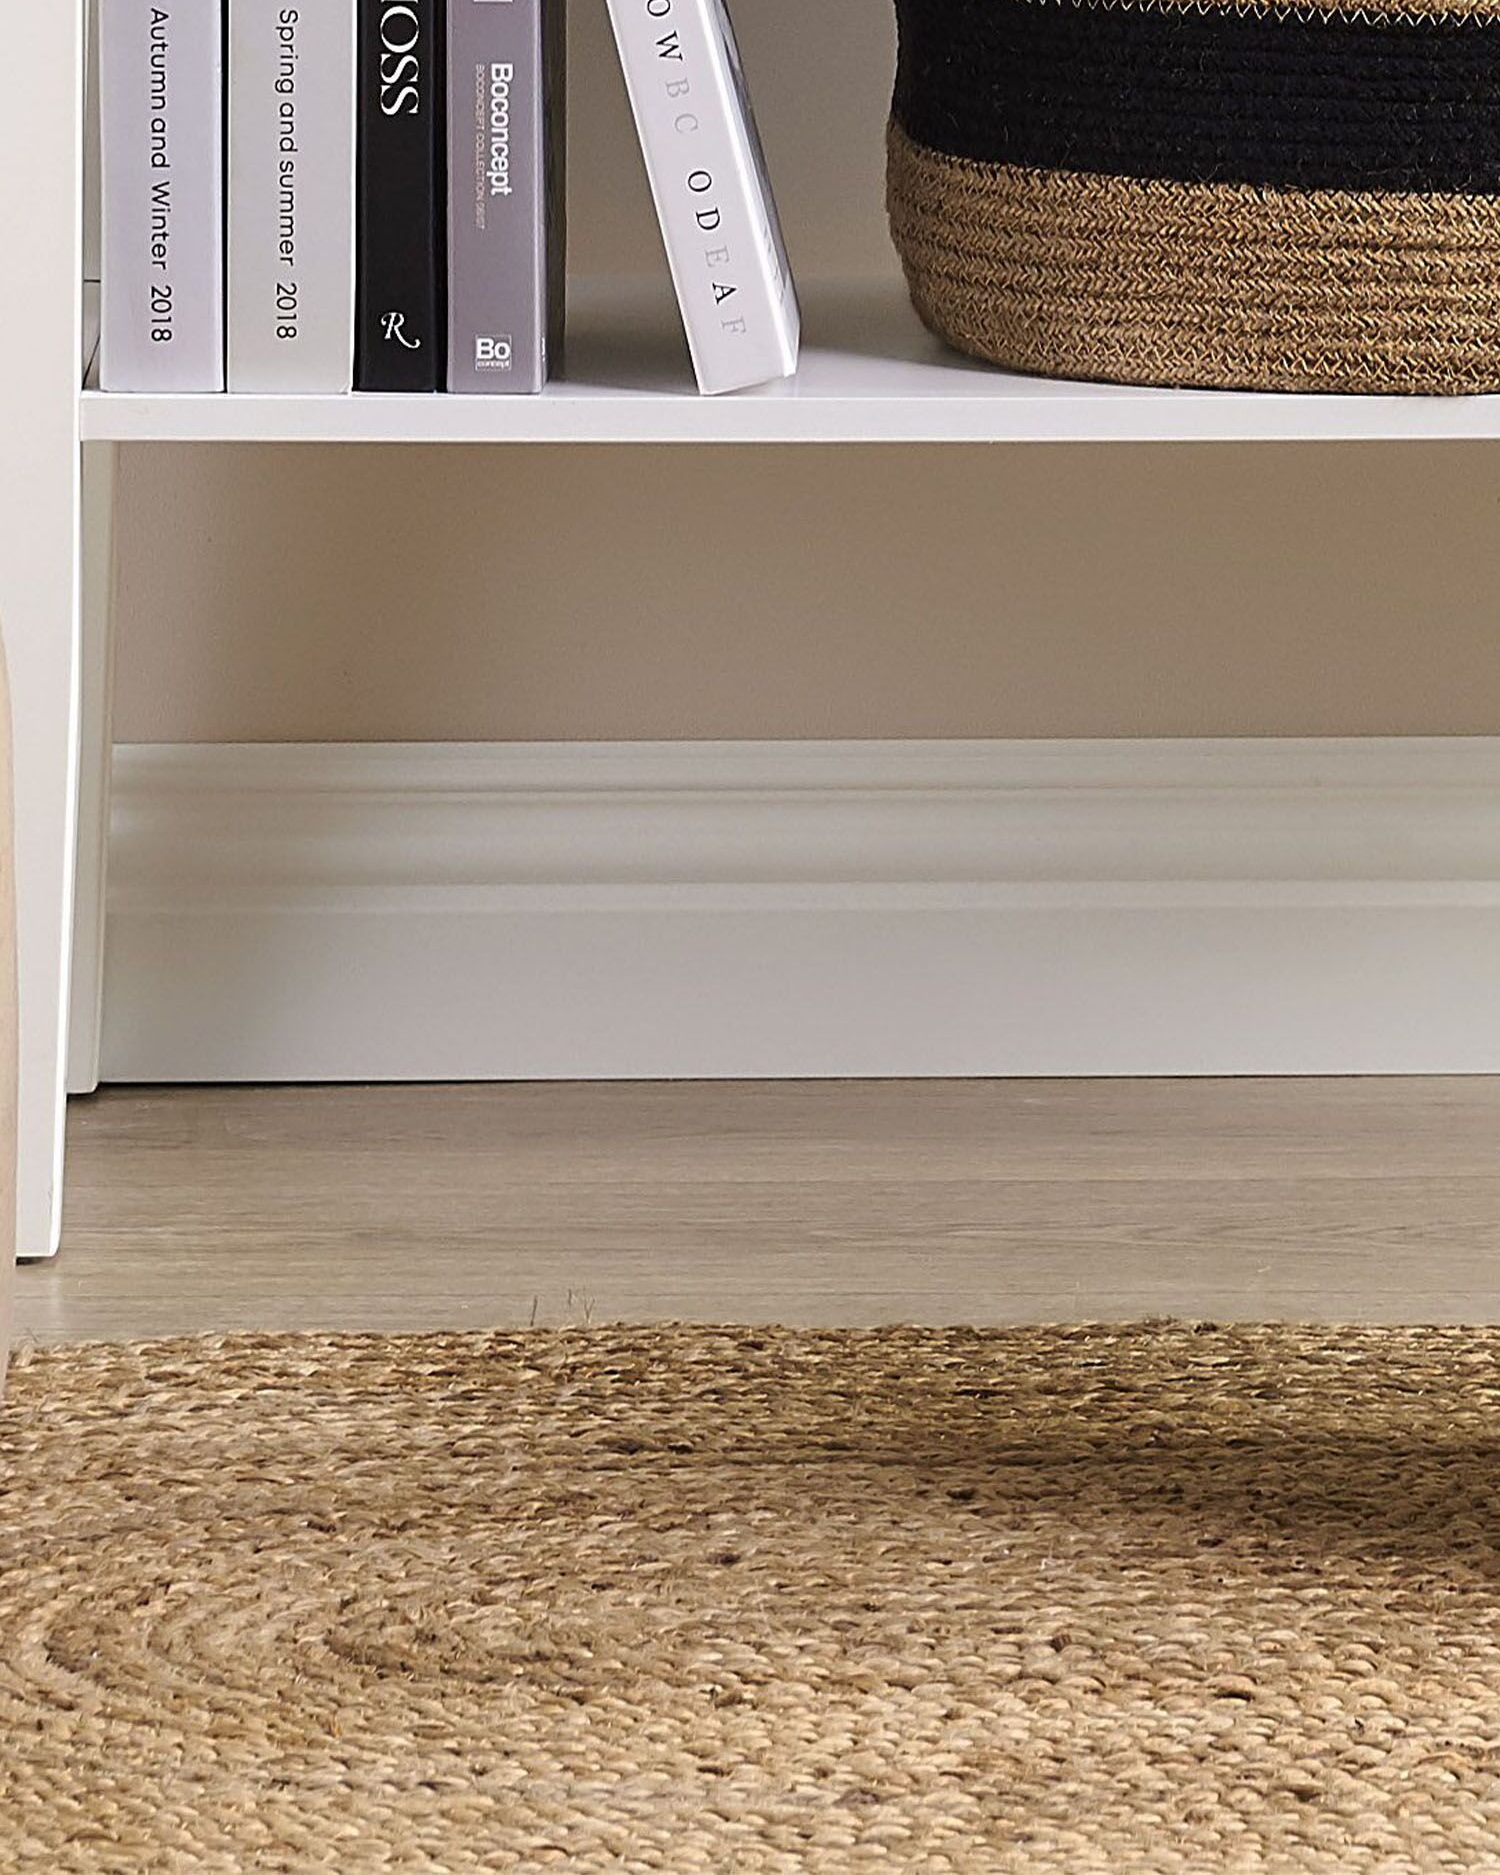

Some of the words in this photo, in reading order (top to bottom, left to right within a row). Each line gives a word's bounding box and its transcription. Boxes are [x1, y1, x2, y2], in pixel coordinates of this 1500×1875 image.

[151, 8, 169, 109] Autumn
[275, 10, 298, 93] Spring
[151, 118, 170, 168] and
[280, 102, 298, 152] and
[487, 63, 513, 196] Boconcept
[151, 181, 171, 270] Winter
[279, 161, 294, 266] summer
[151, 285, 172, 341] 2018
[277, 283, 297, 338] 2018
[476, 338, 511, 360] Bo
